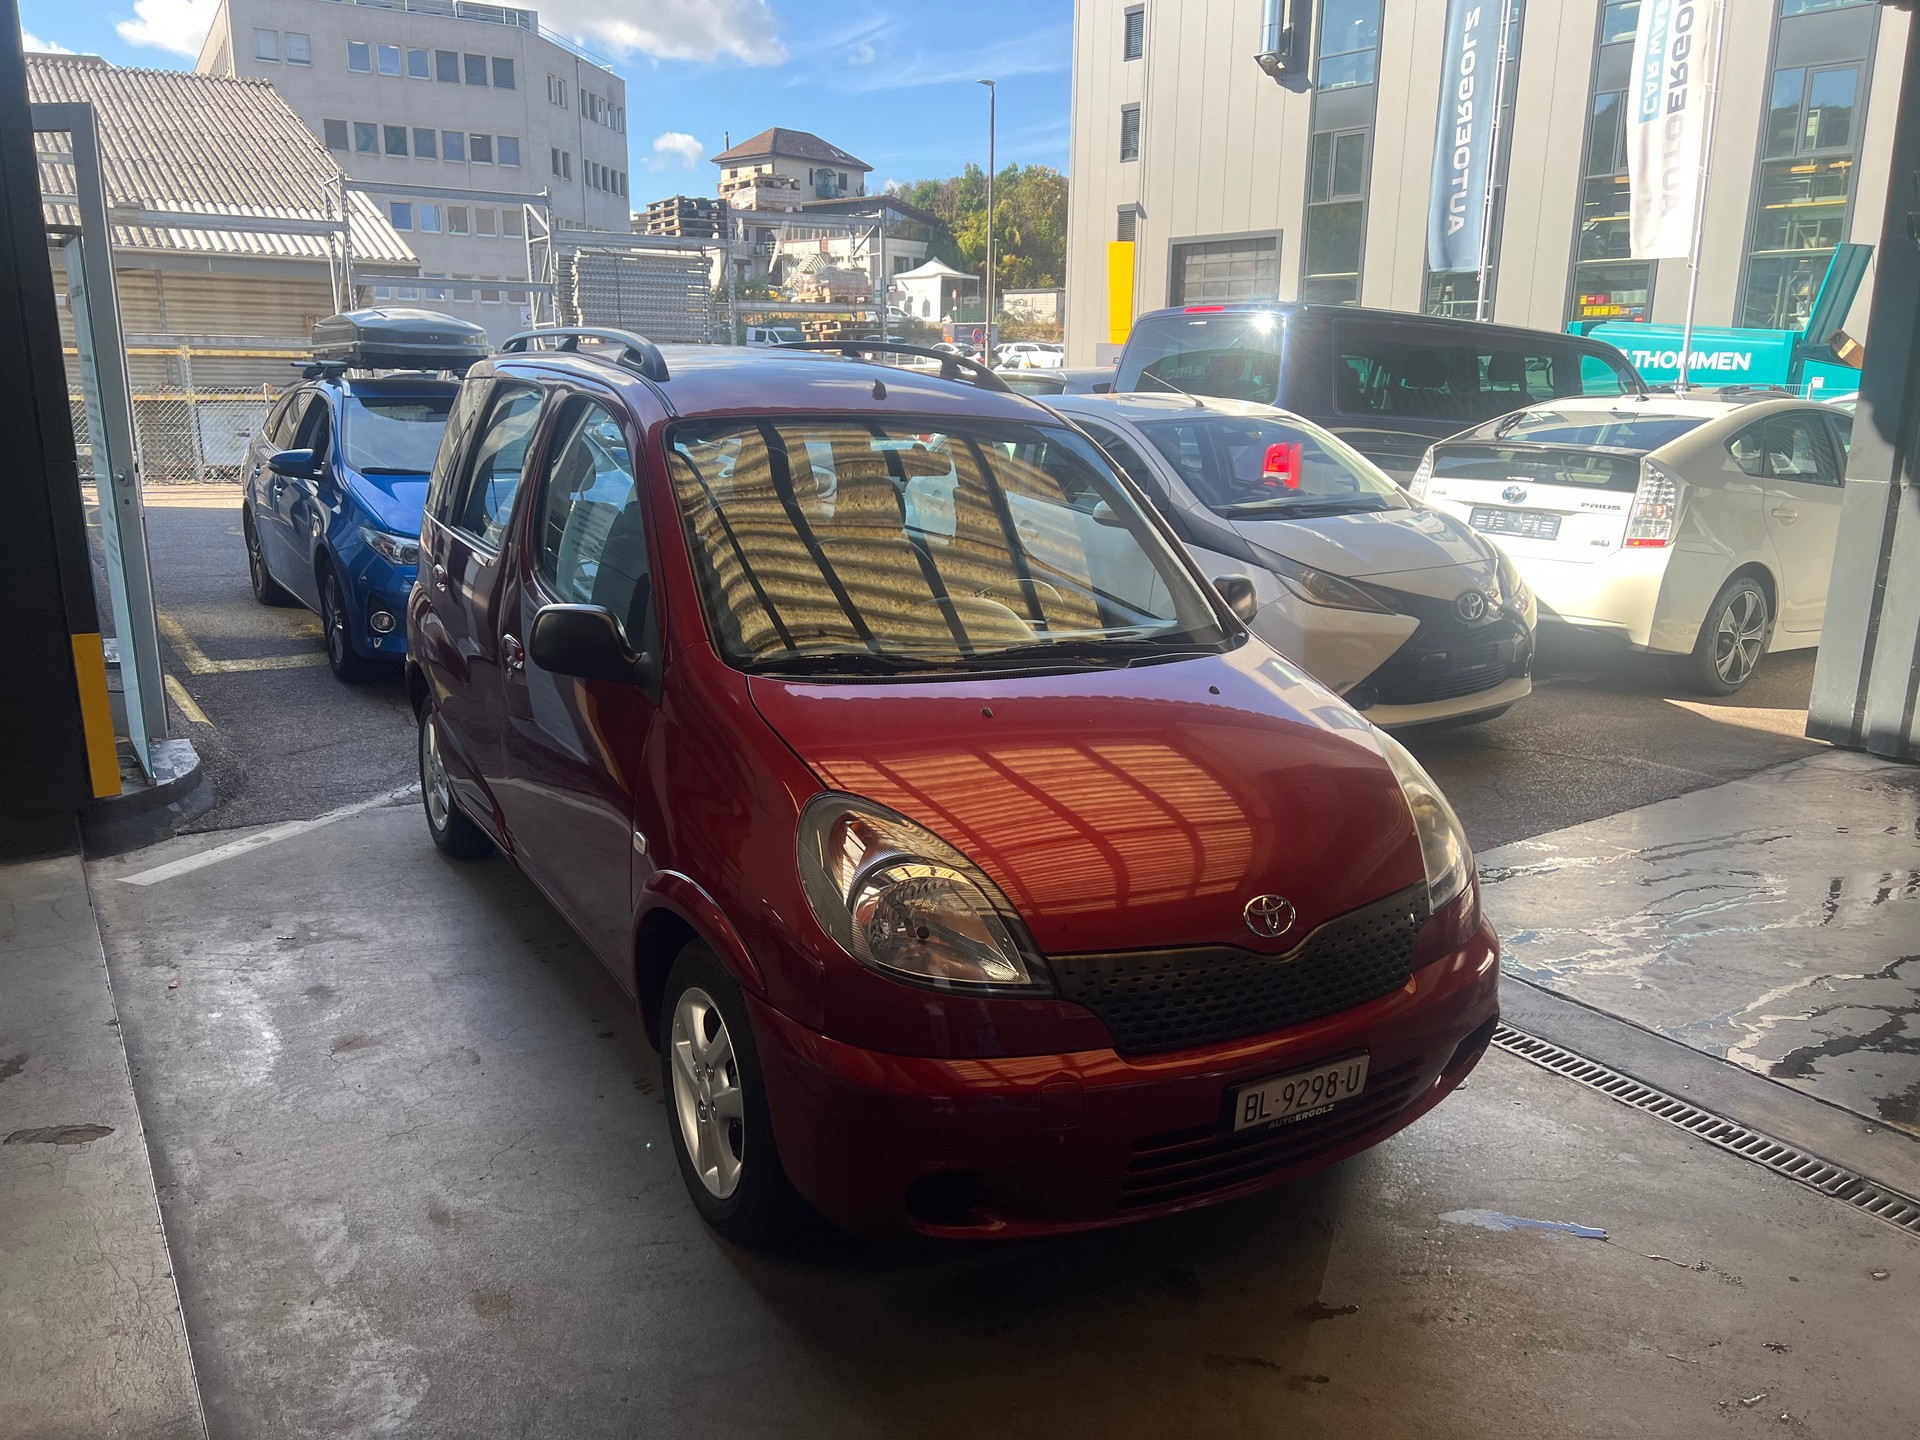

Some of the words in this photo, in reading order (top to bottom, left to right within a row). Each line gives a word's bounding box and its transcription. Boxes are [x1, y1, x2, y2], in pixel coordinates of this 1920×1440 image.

[1632, 350, 1752, 371] THOMMEN
[1580, 502, 1622, 511] PRIUS
[1268, 1103, 1335, 1130] AUTOERGOLZ
